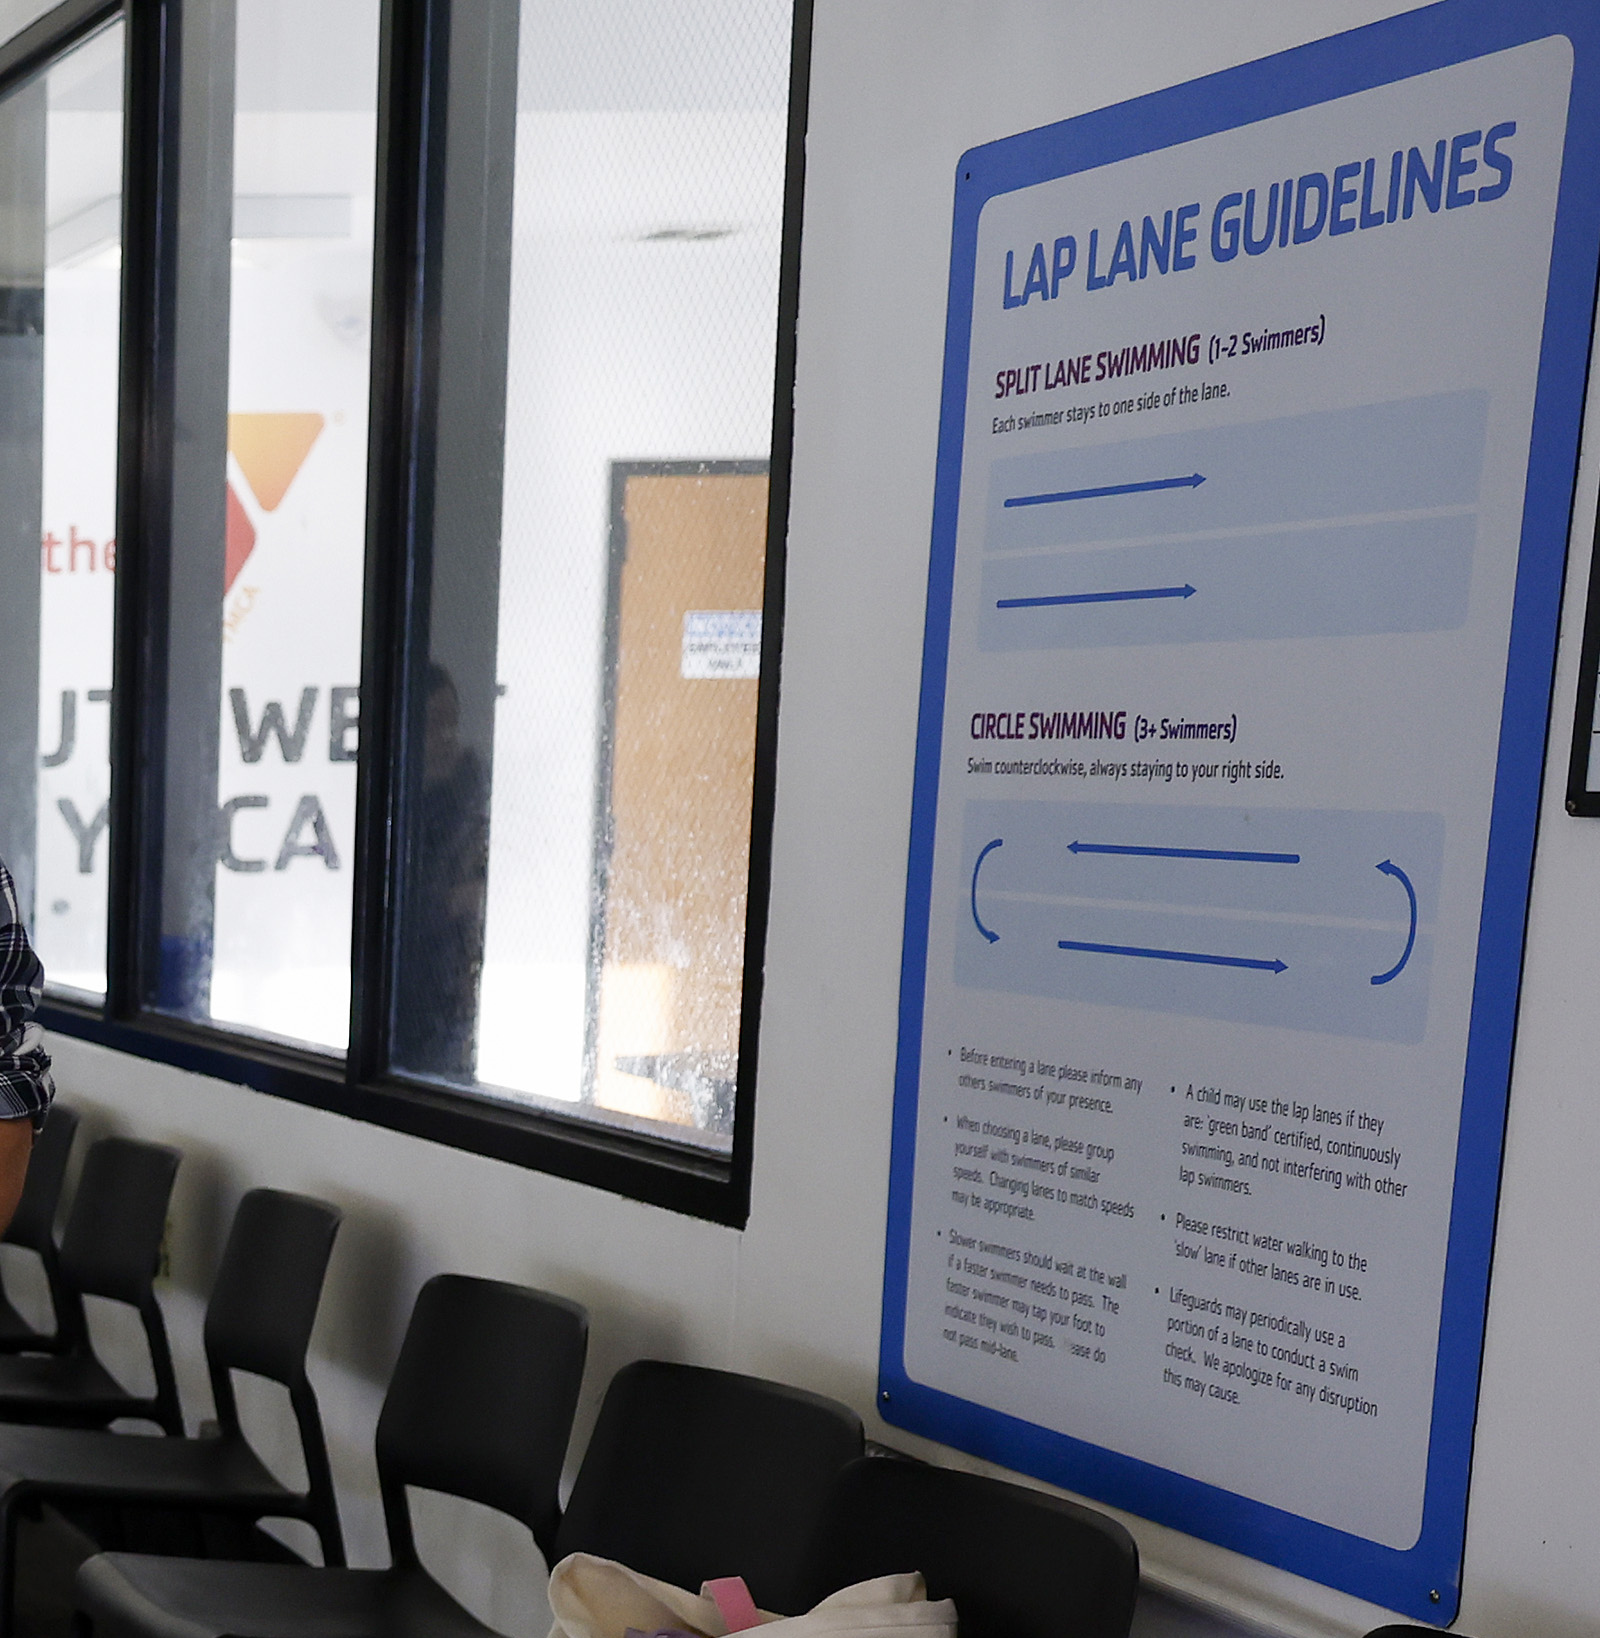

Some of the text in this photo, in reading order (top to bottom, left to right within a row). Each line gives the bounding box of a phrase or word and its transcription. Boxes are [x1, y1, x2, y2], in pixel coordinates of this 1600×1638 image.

[1002, 120, 1517, 310] LAP LANE GUIDELINES
[996, 364, 1041, 399] SPLIT
[1045, 354, 1092, 390] LANE
[1096, 333, 1200, 381] SWIMMING
[1242, 314, 1326, 355] Swimmers)
[992, 383, 1230, 434] Each swimmer stays to one side of the lane.
[971, 711, 1237, 744] CIRCLE SWIMMING (3+ Swimmers)
[967, 757, 1284, 783] Swim counterclockwise, always staying to your right side.
[57, 795, 340, 874] YCA
[1186, 1084, 1384, 1137] A child may use the lap lanes if they
[1182, 1142, 1407, 1197] swimming, and not interfering with other
[1184, 1115, 1203, 1129] are:
[1274, 1130, 1322, 1154] certified,
[1326, 1140, 1401, 1170] continuously
[1179, 1165, 1251, 1196] lap swimmers.
[1176, 1212, 1367, 1272] Please restrict water walking to the
[1204, 1246, 1225, 1267] lane
[1228, 1253, 1237, 1269] if
[1239, 1258, 1268, 1277] other
[1271, 1263, 1299, 1286] lanes
[1302, 1275, 1321, 1291] are
[1324, 1277, 1335, 1294] in
[1338, 1284, 1361, 1301] use.
[1169, 1287, 1346, 1348] Lifeguards may periodically use a
[1167, 1317, 1359, 1381] portion of a lane to conduct a swim
[1163, 1367, 1239, 1404] this may cause.
[1165, 1342, 1378, 1417] check. We apologize for any disruption
